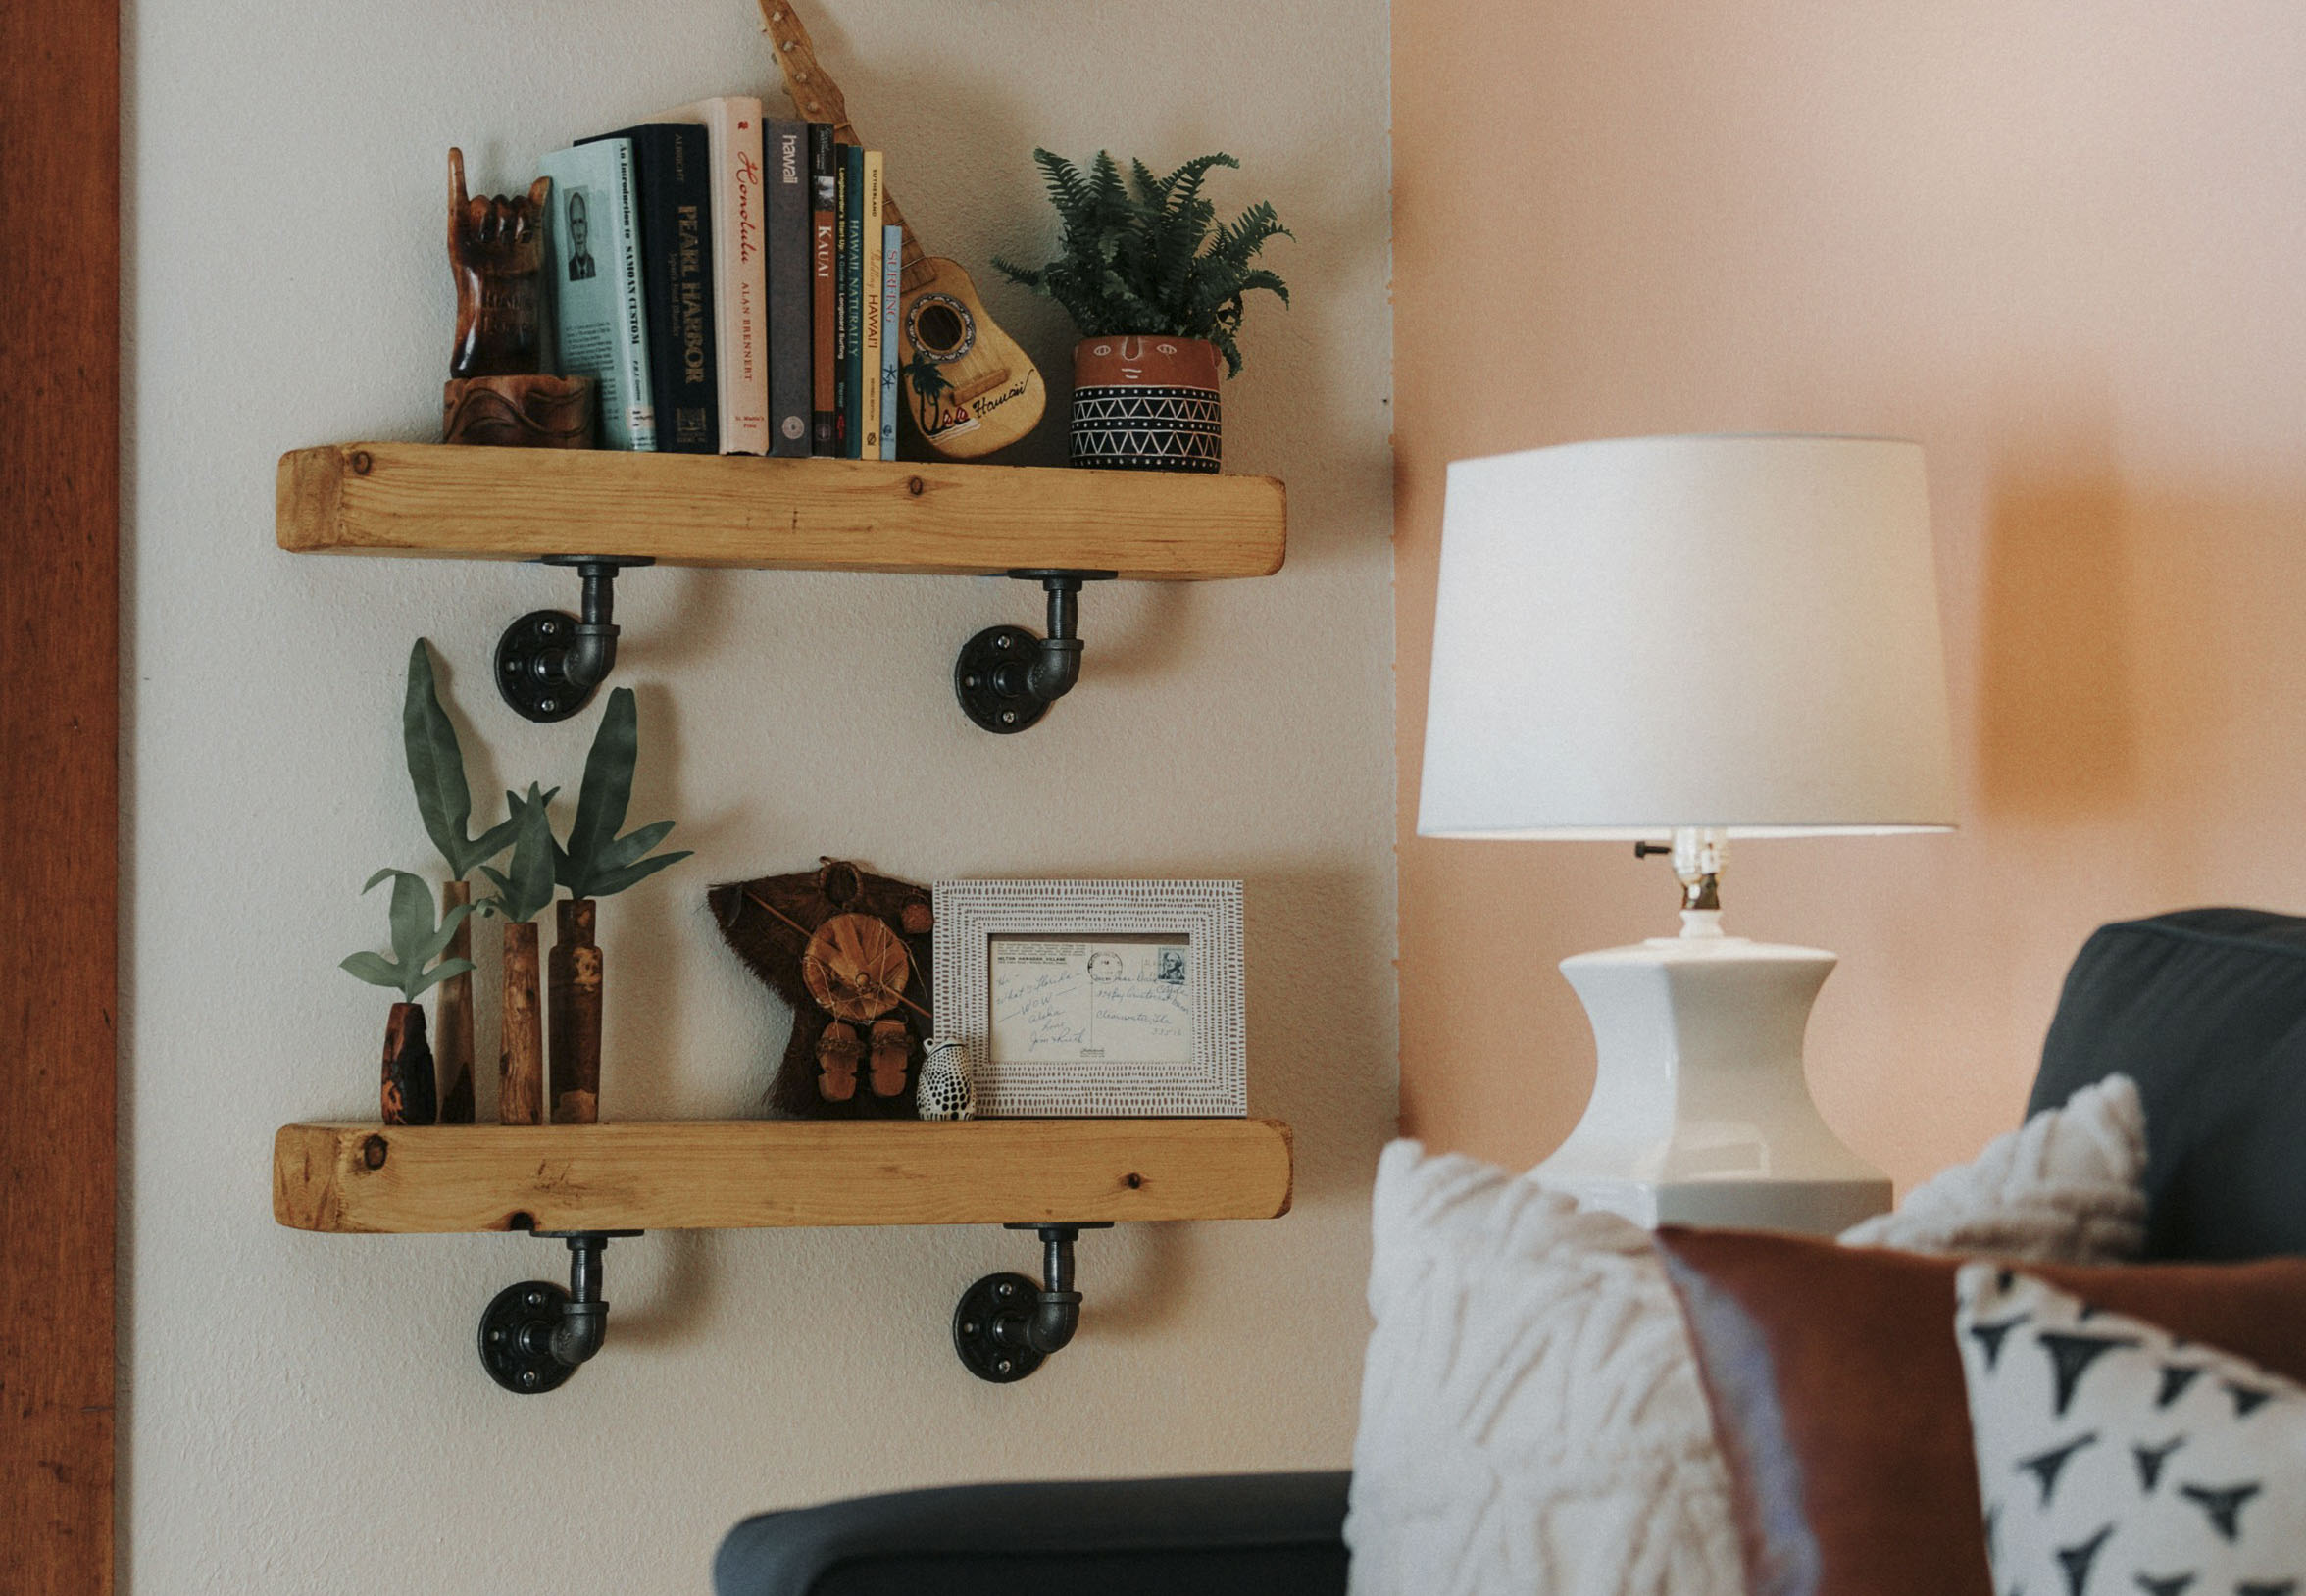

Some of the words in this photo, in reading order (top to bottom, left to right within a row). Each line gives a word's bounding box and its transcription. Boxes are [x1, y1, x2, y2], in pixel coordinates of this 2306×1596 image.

[620, 144, 627, 159] An
[782, 135, 798, 184] hawaii
[620, 163, 630, 226] Introduction
[736, 151, 759, 264] Honolulu
[624, 228, 630, 239] to
[678, 206, 700, 275] PEARL
[818, 225, 831, 277] KAUAI
[626, 246, 636, 295] SAMOAN
[868, 249, 882, 288] Paddling
[885, 249, 897, 324] SURFING
[628, 297, 640, 344] CUSTOM
[740, 282, 750, 314] ALAN
[847, 277, 860, 357] NATURALLY
[868, 294, 878, 349] HAWAI'I
[682, 282, 705, 384] HARBOR
[742, 319, 753, 382] BRENNERT
[973, 369, 1034, 418] Hawaii
